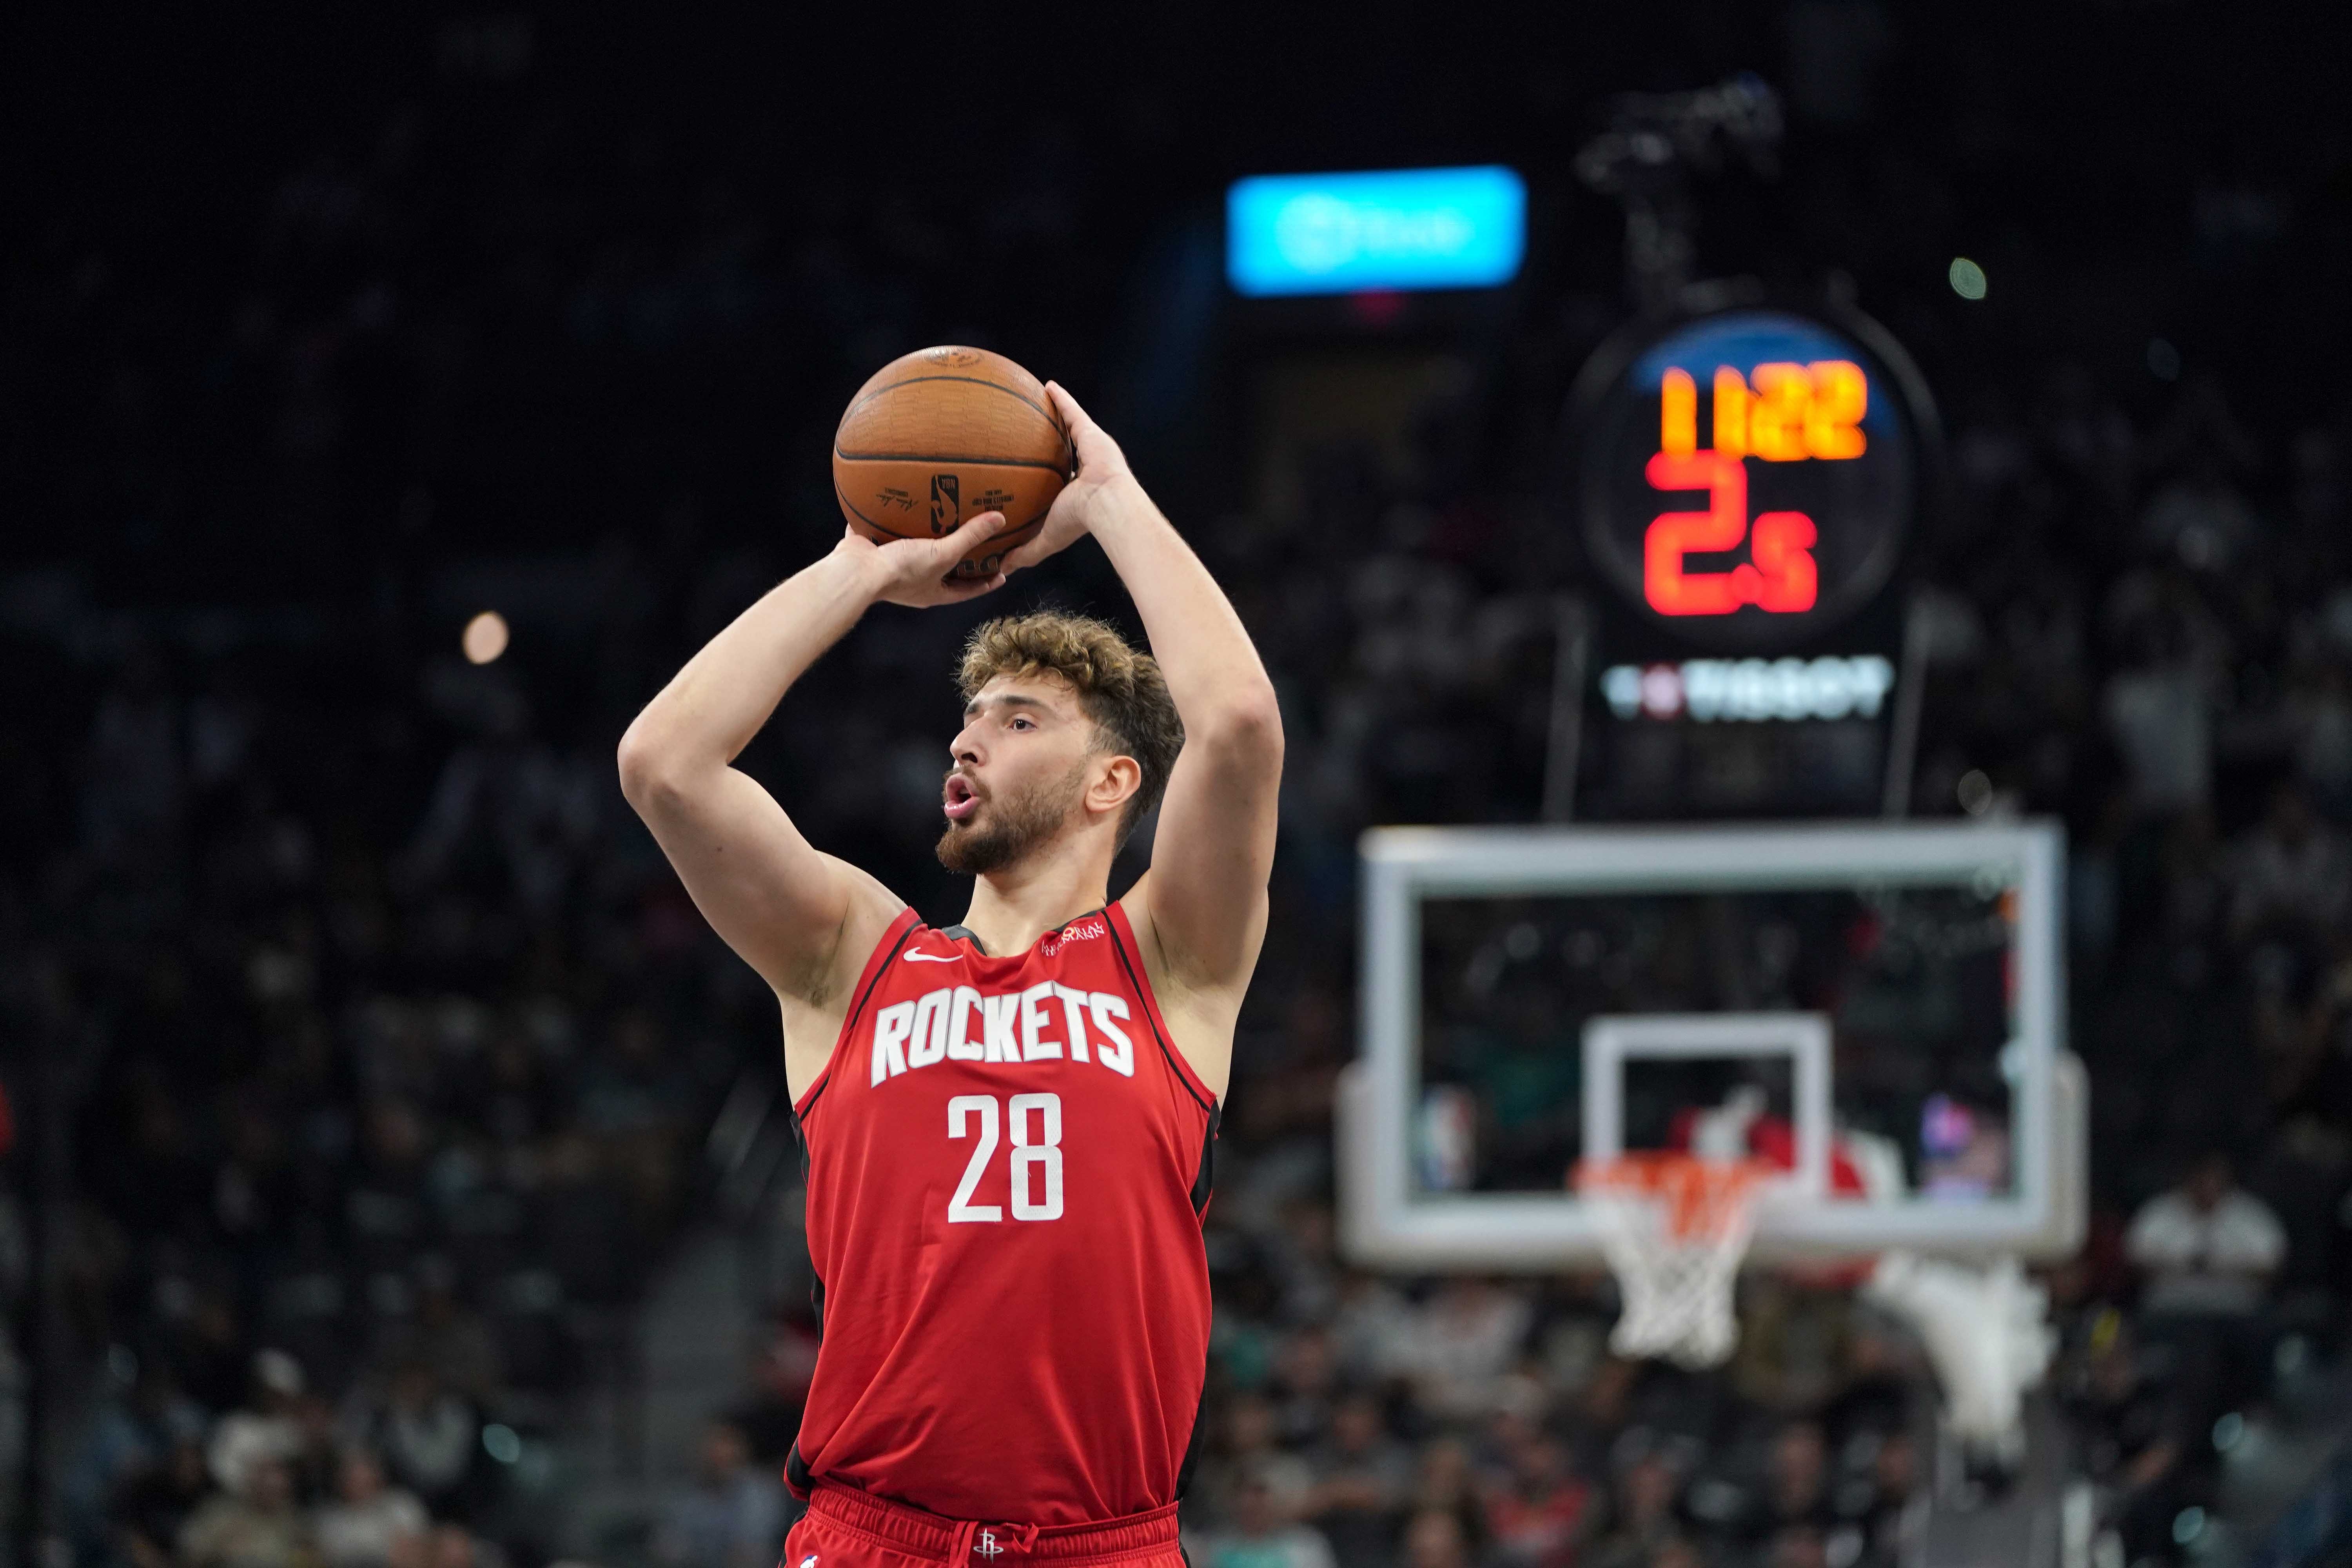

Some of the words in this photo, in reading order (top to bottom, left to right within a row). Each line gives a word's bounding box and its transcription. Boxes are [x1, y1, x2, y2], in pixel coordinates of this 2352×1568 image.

[941, 477, 956, 490] NBA
[871, 980, 1134, 1089] ROCKETS
[948, 1093, 1063, 1223] 28
